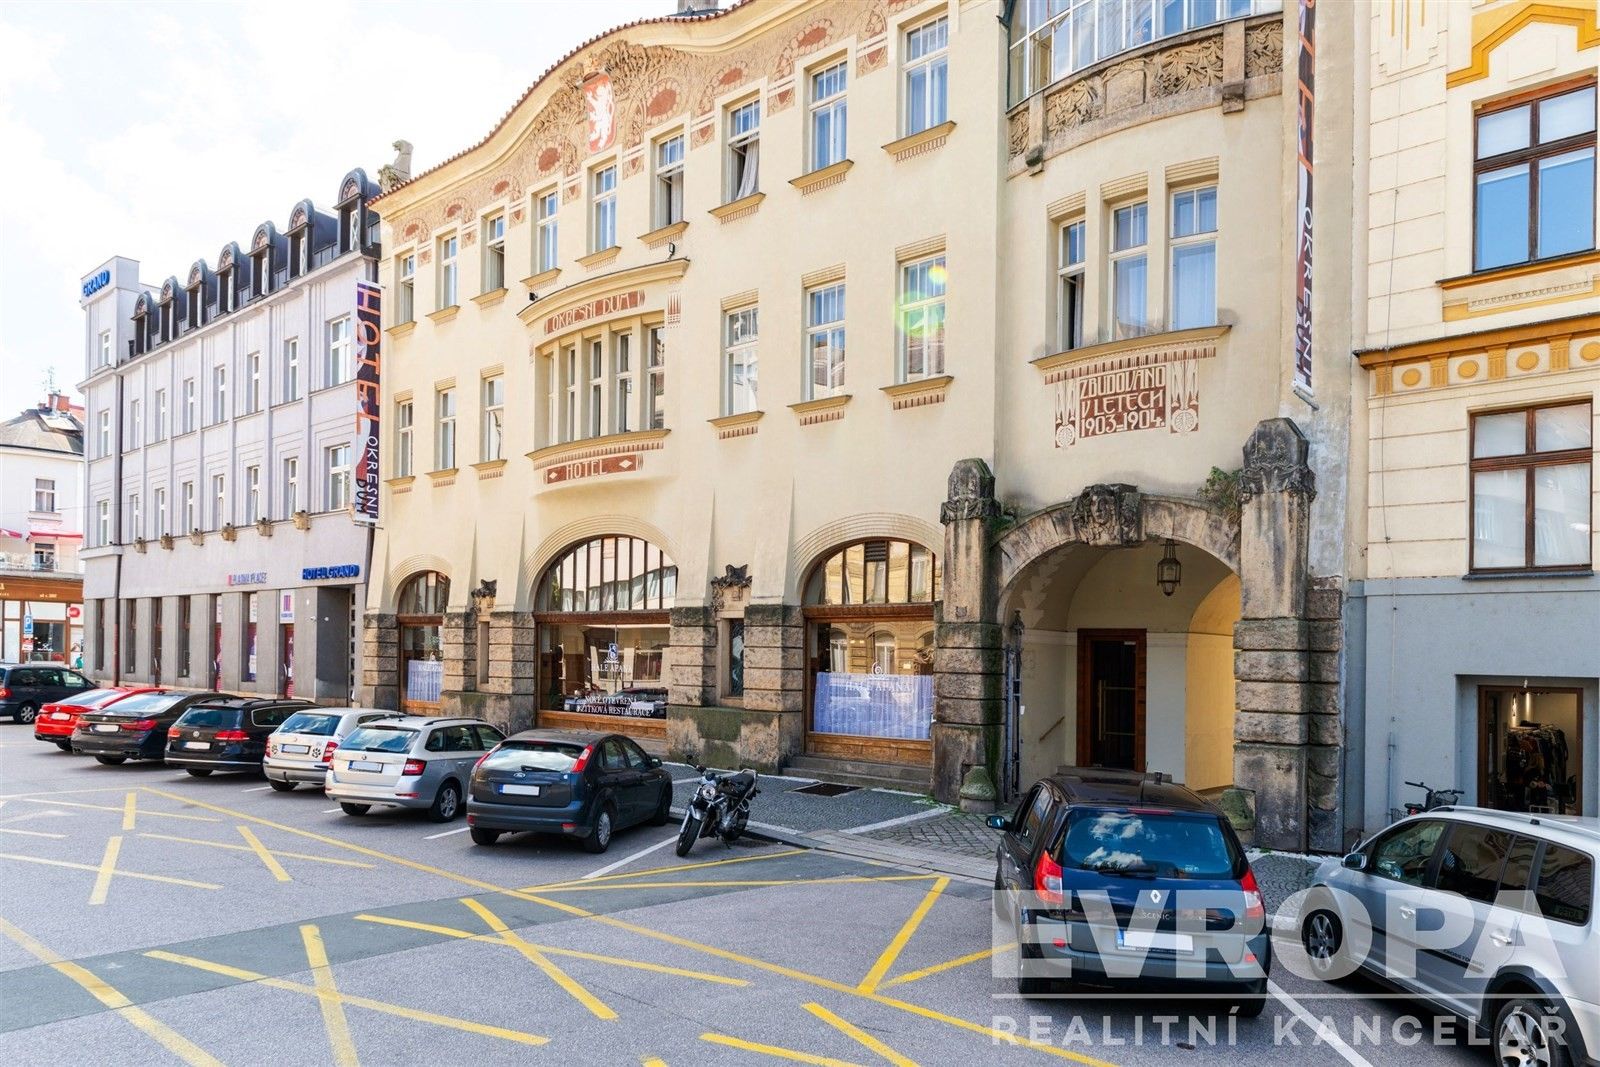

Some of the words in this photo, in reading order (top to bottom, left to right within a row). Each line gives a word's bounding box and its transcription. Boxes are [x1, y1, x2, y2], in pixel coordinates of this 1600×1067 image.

[83, 270, 110, 297] GRAND
[356, 285, 381, 435] HOTEL
[1081, 399, 1091, 419] V
[1094, 388, 1164, 416] LETECH
[566, 459, 609, 480] HOTEL
[303, 567, 327, 580] HOTEL
[327, 564, 360, 579] GRAND
